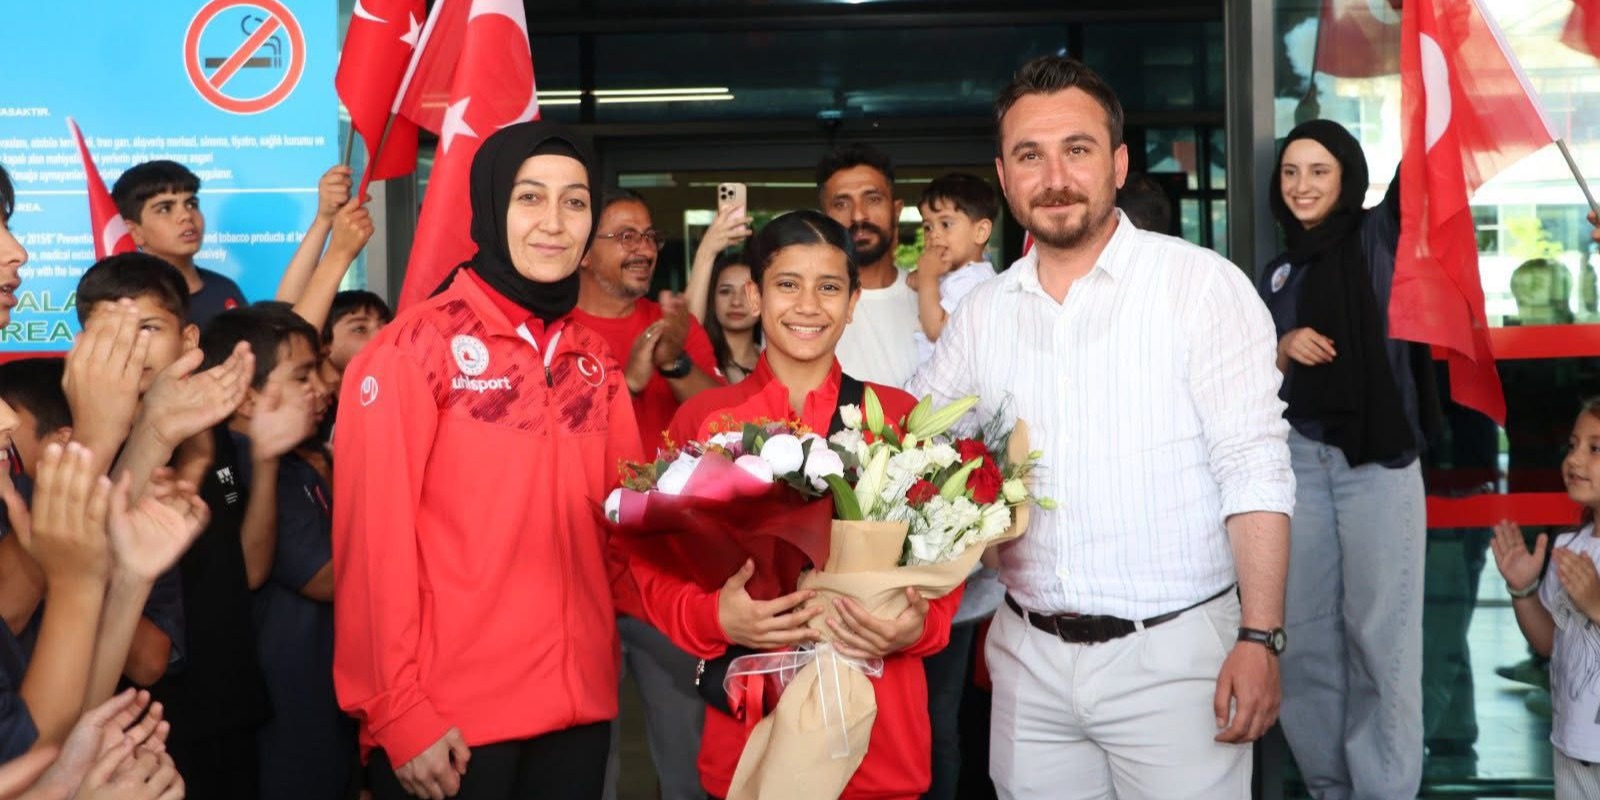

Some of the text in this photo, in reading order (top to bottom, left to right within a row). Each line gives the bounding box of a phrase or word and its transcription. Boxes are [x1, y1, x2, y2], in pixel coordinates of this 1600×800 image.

[56, 233, 94, 244] Preventio
[251, 232, 285, 245] products
[451, 374, 512, 393] uhlsport
